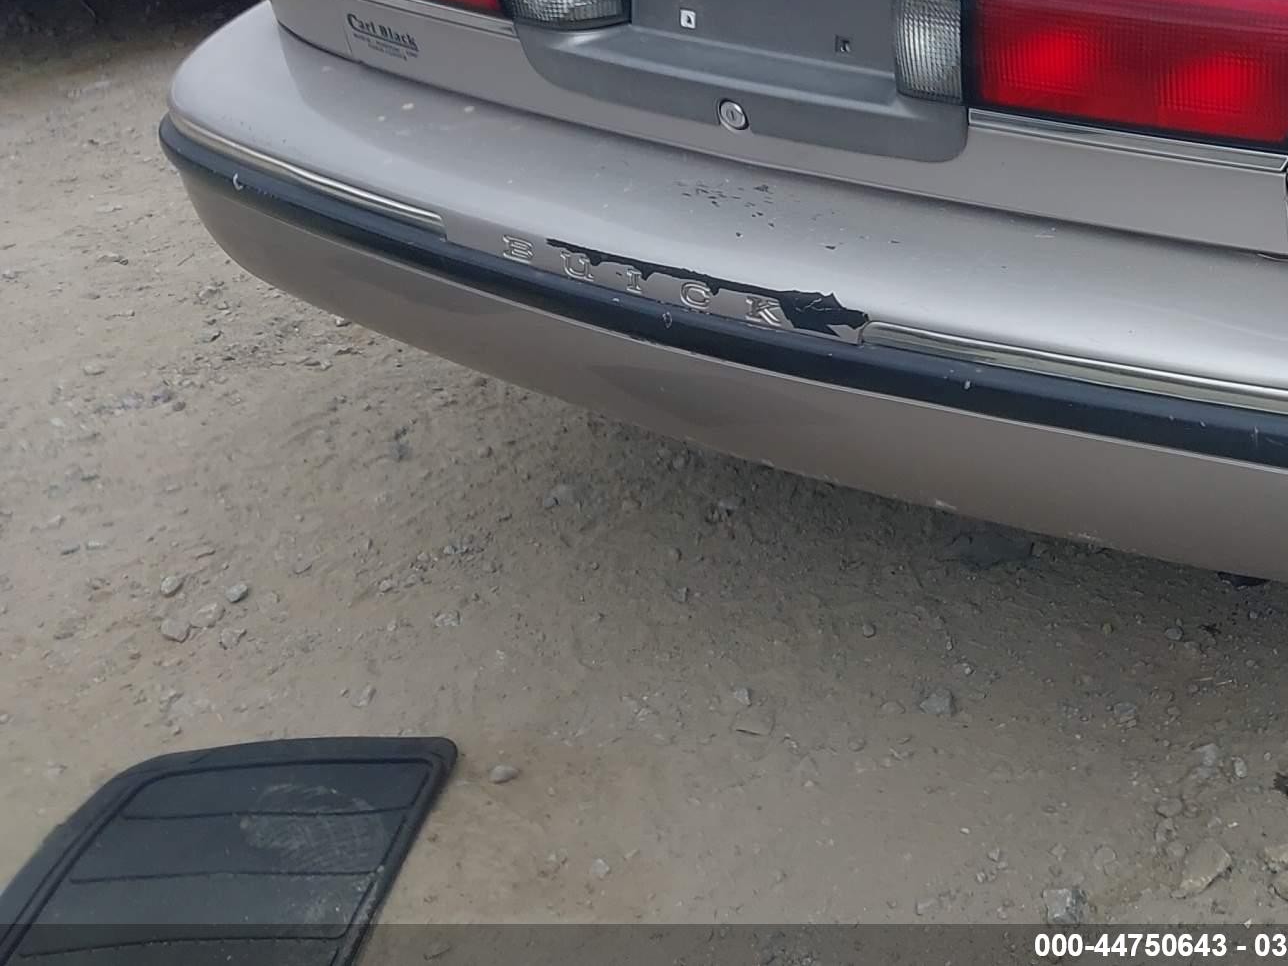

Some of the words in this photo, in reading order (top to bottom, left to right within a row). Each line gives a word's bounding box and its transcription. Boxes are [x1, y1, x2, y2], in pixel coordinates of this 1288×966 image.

[346, 12, 377, 35] Carl
[377, 24, 420, 52] Black
[501, 233, 784, 328] BUICK
